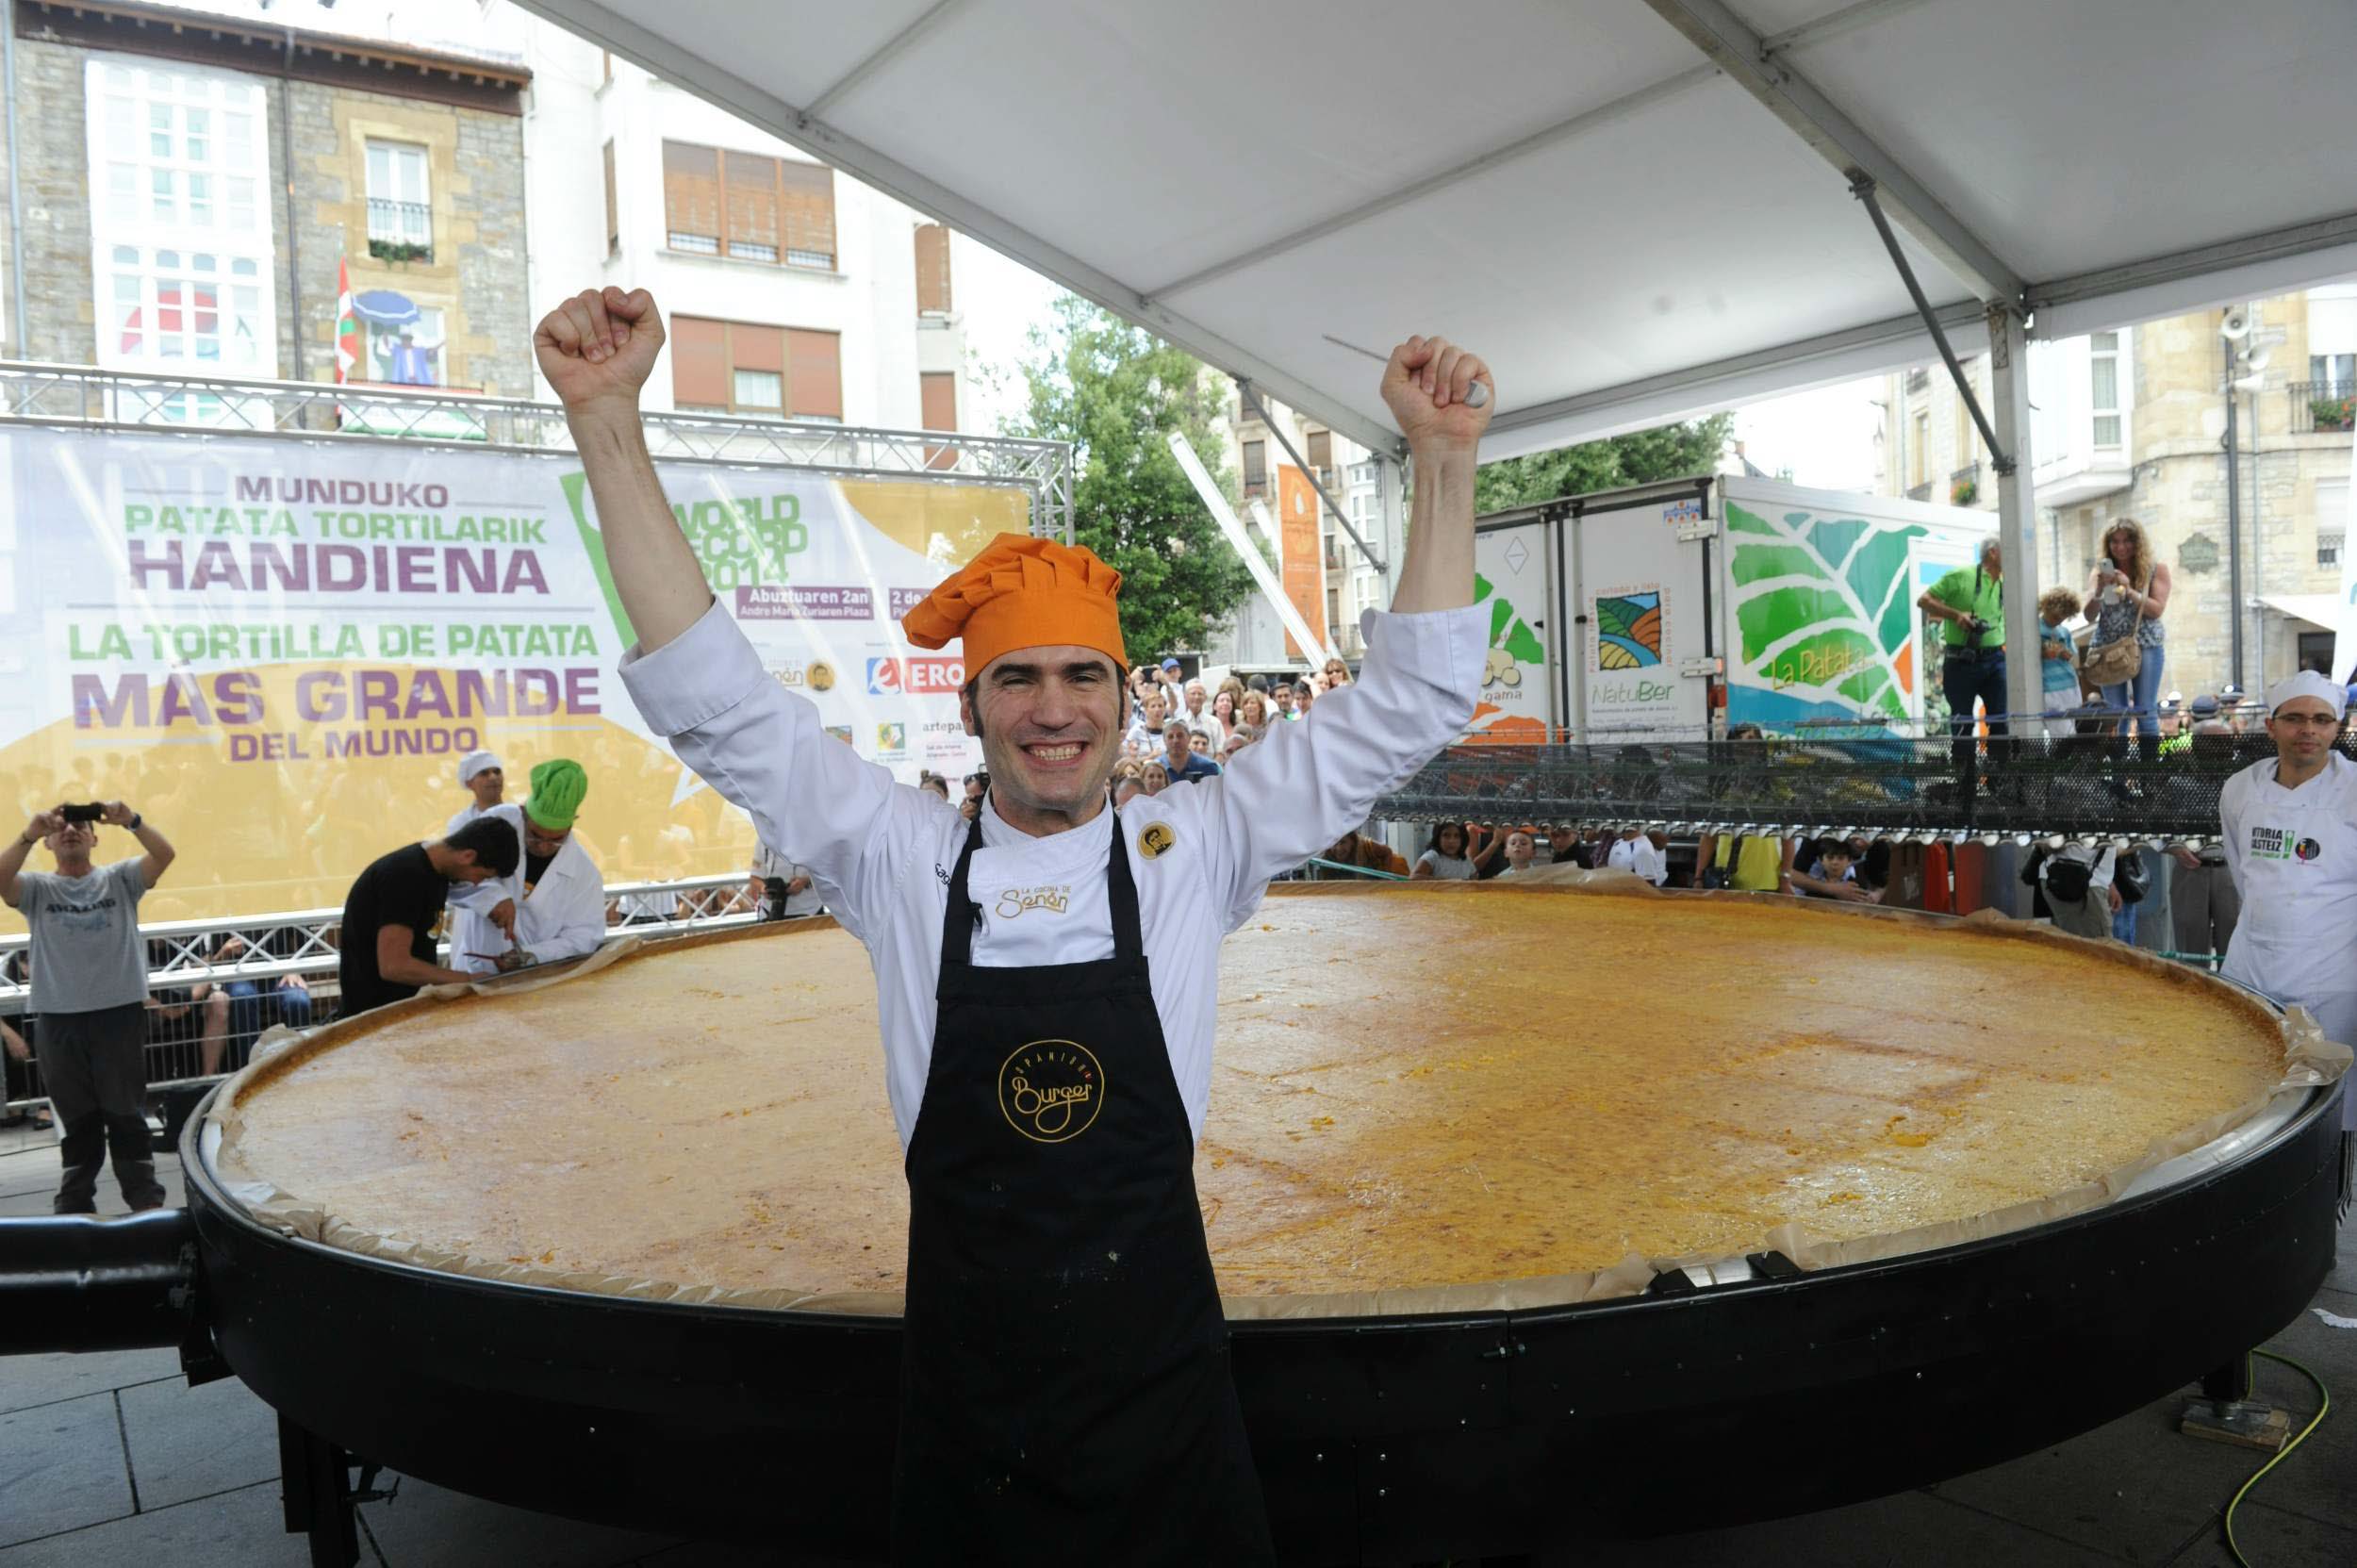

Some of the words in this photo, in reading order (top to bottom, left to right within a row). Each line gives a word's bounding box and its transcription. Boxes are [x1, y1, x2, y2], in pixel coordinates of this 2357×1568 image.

[235, 476, 449, 508] MUNDUKO
[124, 504, 299, 536] PATATA
[312, 511, 548, 544] TORTILARIK
[127, 539, 551, 595] HANDIENA
[750, 588, 839, 603] Abuztuaren
[842, 590, 867, 603] 2an
[892, 591, 902, 604] 2
[905, 591, 921, 604] de
[69, 624, 133, 660] LA
[143, 623, 366, 659] TORTILLA
[378, 624, 436, 657] DE
[448, 624, 600, 656] PATATA
[911, 663, 965, 687] ERO
[1772, 657, 1795, 691] La
[295, 668, 602, 724] GRANDE
[1591, 681, 1675, 704] NatuBer
[230, 734, 309, 762] DEL
[325, 727, 478, 759] MUNDO
[923, 722, 964, 734] artepa
[1012, 1076, 1093, 1133] Burger
